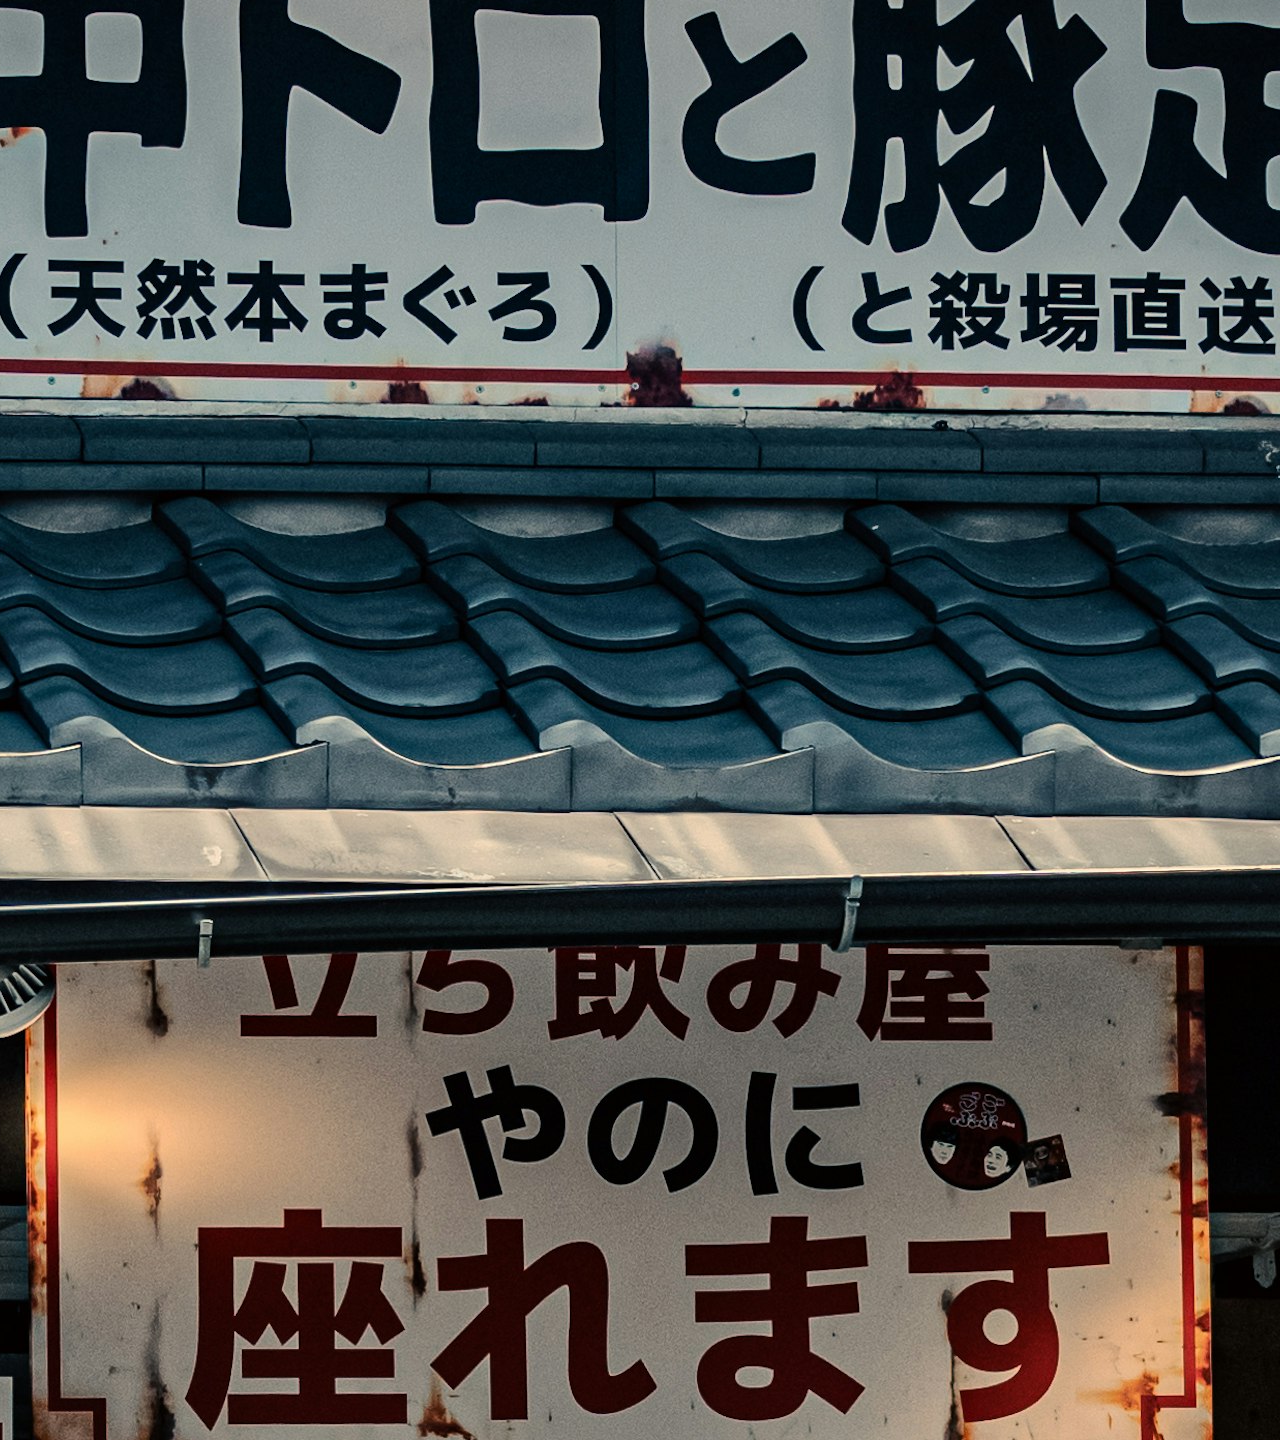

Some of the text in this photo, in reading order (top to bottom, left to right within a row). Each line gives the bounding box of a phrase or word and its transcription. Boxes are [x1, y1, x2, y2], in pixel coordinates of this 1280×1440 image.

[426, 1065, 867, 1200] やのに
[185, 1209, 1110, 1429] 座れます
